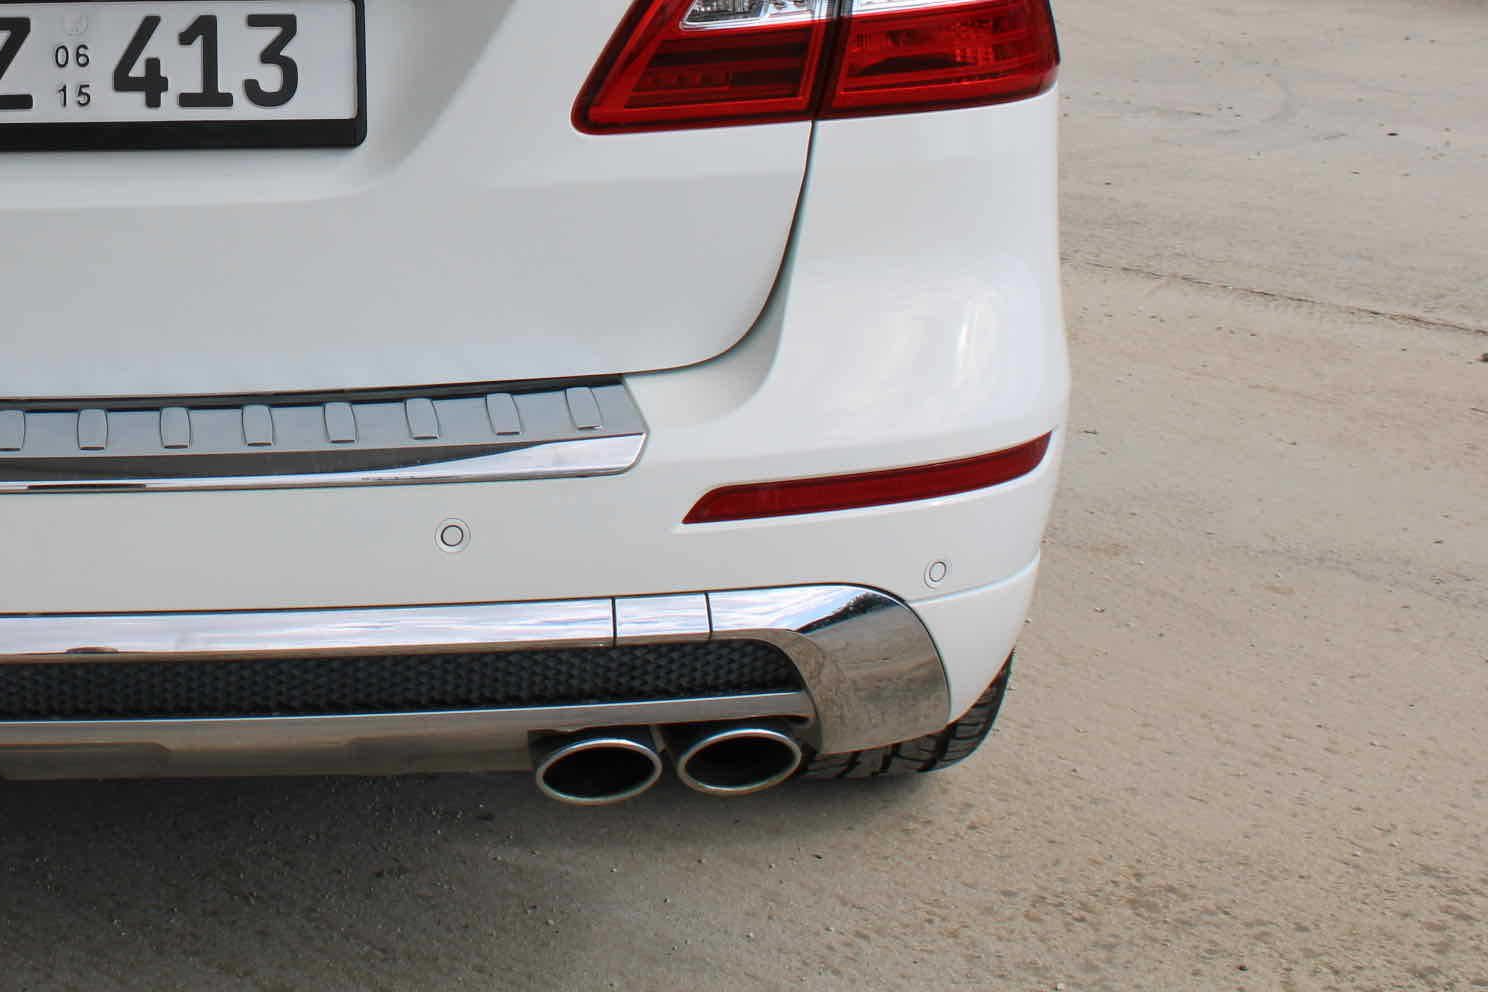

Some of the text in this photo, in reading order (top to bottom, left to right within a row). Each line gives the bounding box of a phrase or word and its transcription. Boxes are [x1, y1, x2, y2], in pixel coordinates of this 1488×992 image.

[54, 44, 90, 68] 06
[112, 13, 299, 108] 413
[57, 83, 91, 107] 15
